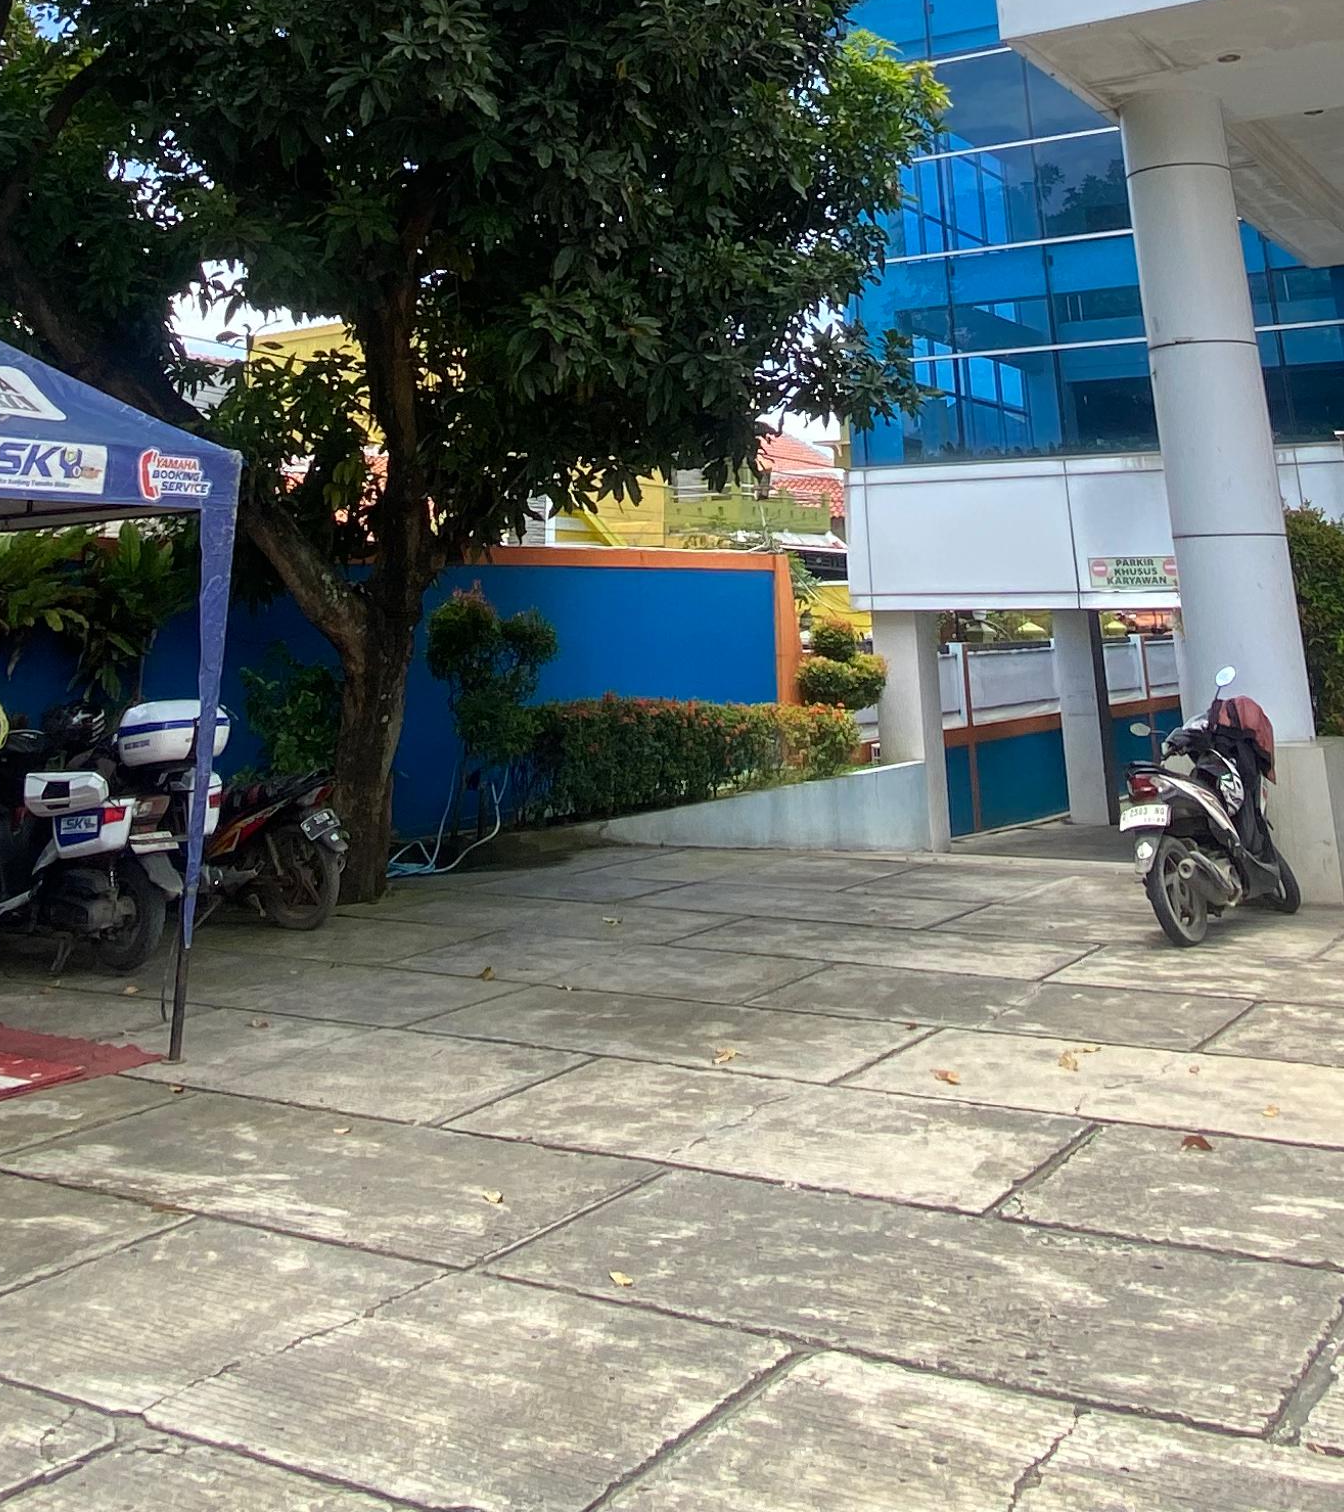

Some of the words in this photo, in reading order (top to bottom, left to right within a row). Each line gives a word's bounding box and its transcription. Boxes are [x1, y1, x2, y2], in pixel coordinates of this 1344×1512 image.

[156, 456, 198, 470] YAMAHA
[152, 469, 201, 482] BOOKING
[160, 481, 209, 494] SERVICE
[1116, 558, 1154, 567] PARKIR
[1114, 567, 1158, 576] KHUSUS
[1106, 576, 1167, 585] KARYAWAN
